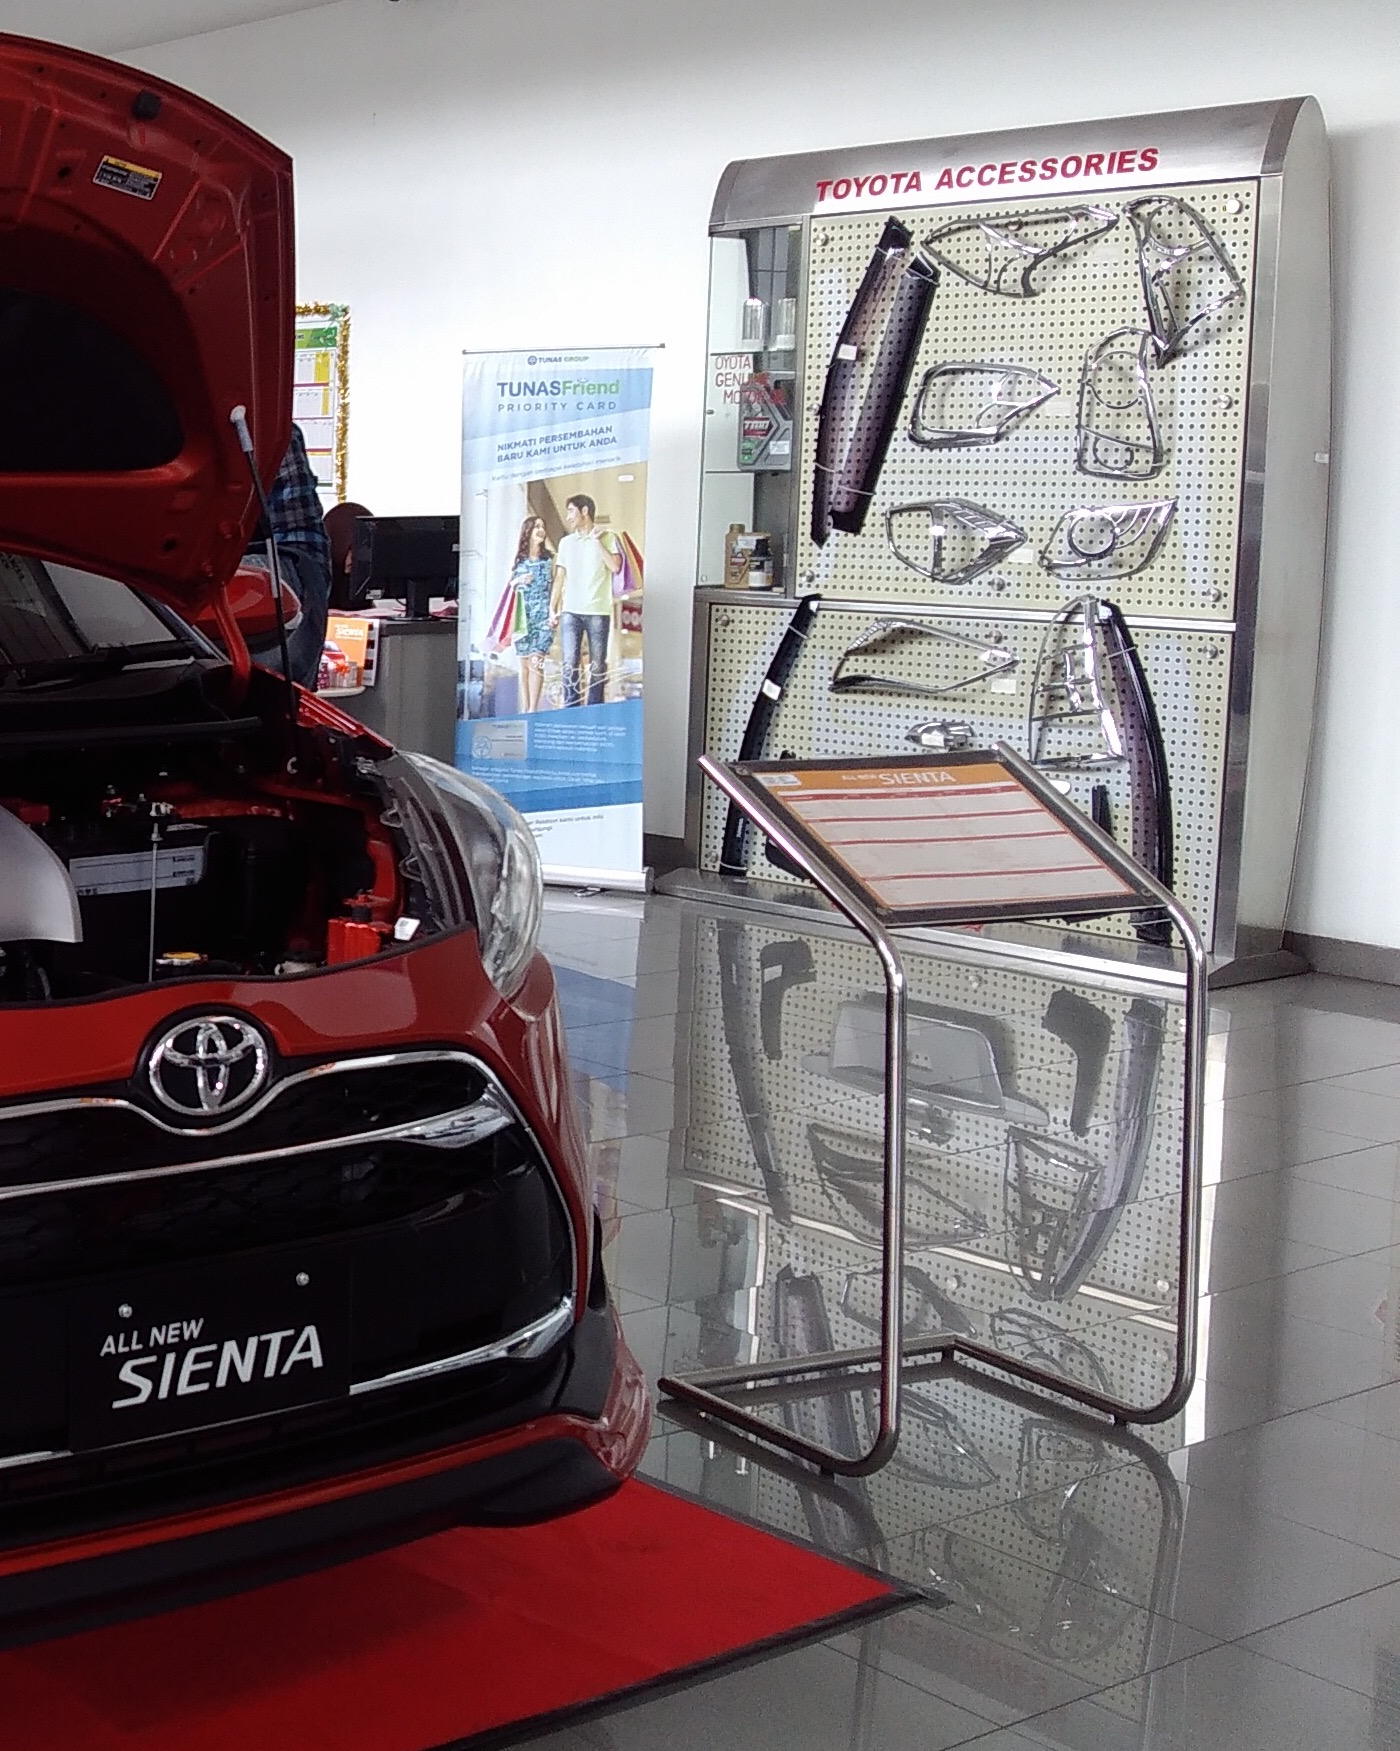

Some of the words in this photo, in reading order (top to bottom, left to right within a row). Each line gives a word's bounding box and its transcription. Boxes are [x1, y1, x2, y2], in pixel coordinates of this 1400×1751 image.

[815, 170, 923, 204] TOYOTA
[935, 146, 1160, 191] ACCESSORIES
[538, 356, 563, 365] TUNAS
[563, 355, 590, 363] GROUP
[497, 402, 569, 412] PRIORITY
[576, 401, 617, 411] CARD
[497, 437, 537, 452] NIKMATI
[539, 425, 613, 445] PERSEMBAHAN
[497, 451, 524, 463] BARU
[526, 447, 551, 459] KAMI
[553, 442, 587, 455] UNTUK
[589, 436, 618, 449] ANDA
[879, 771, 957, 785] SIENTA
[100, 1331, 144, 1357] ALL
[149, 1318, 204, 1347] NEW
[112, 1324, 324, 1409] SIENTA
